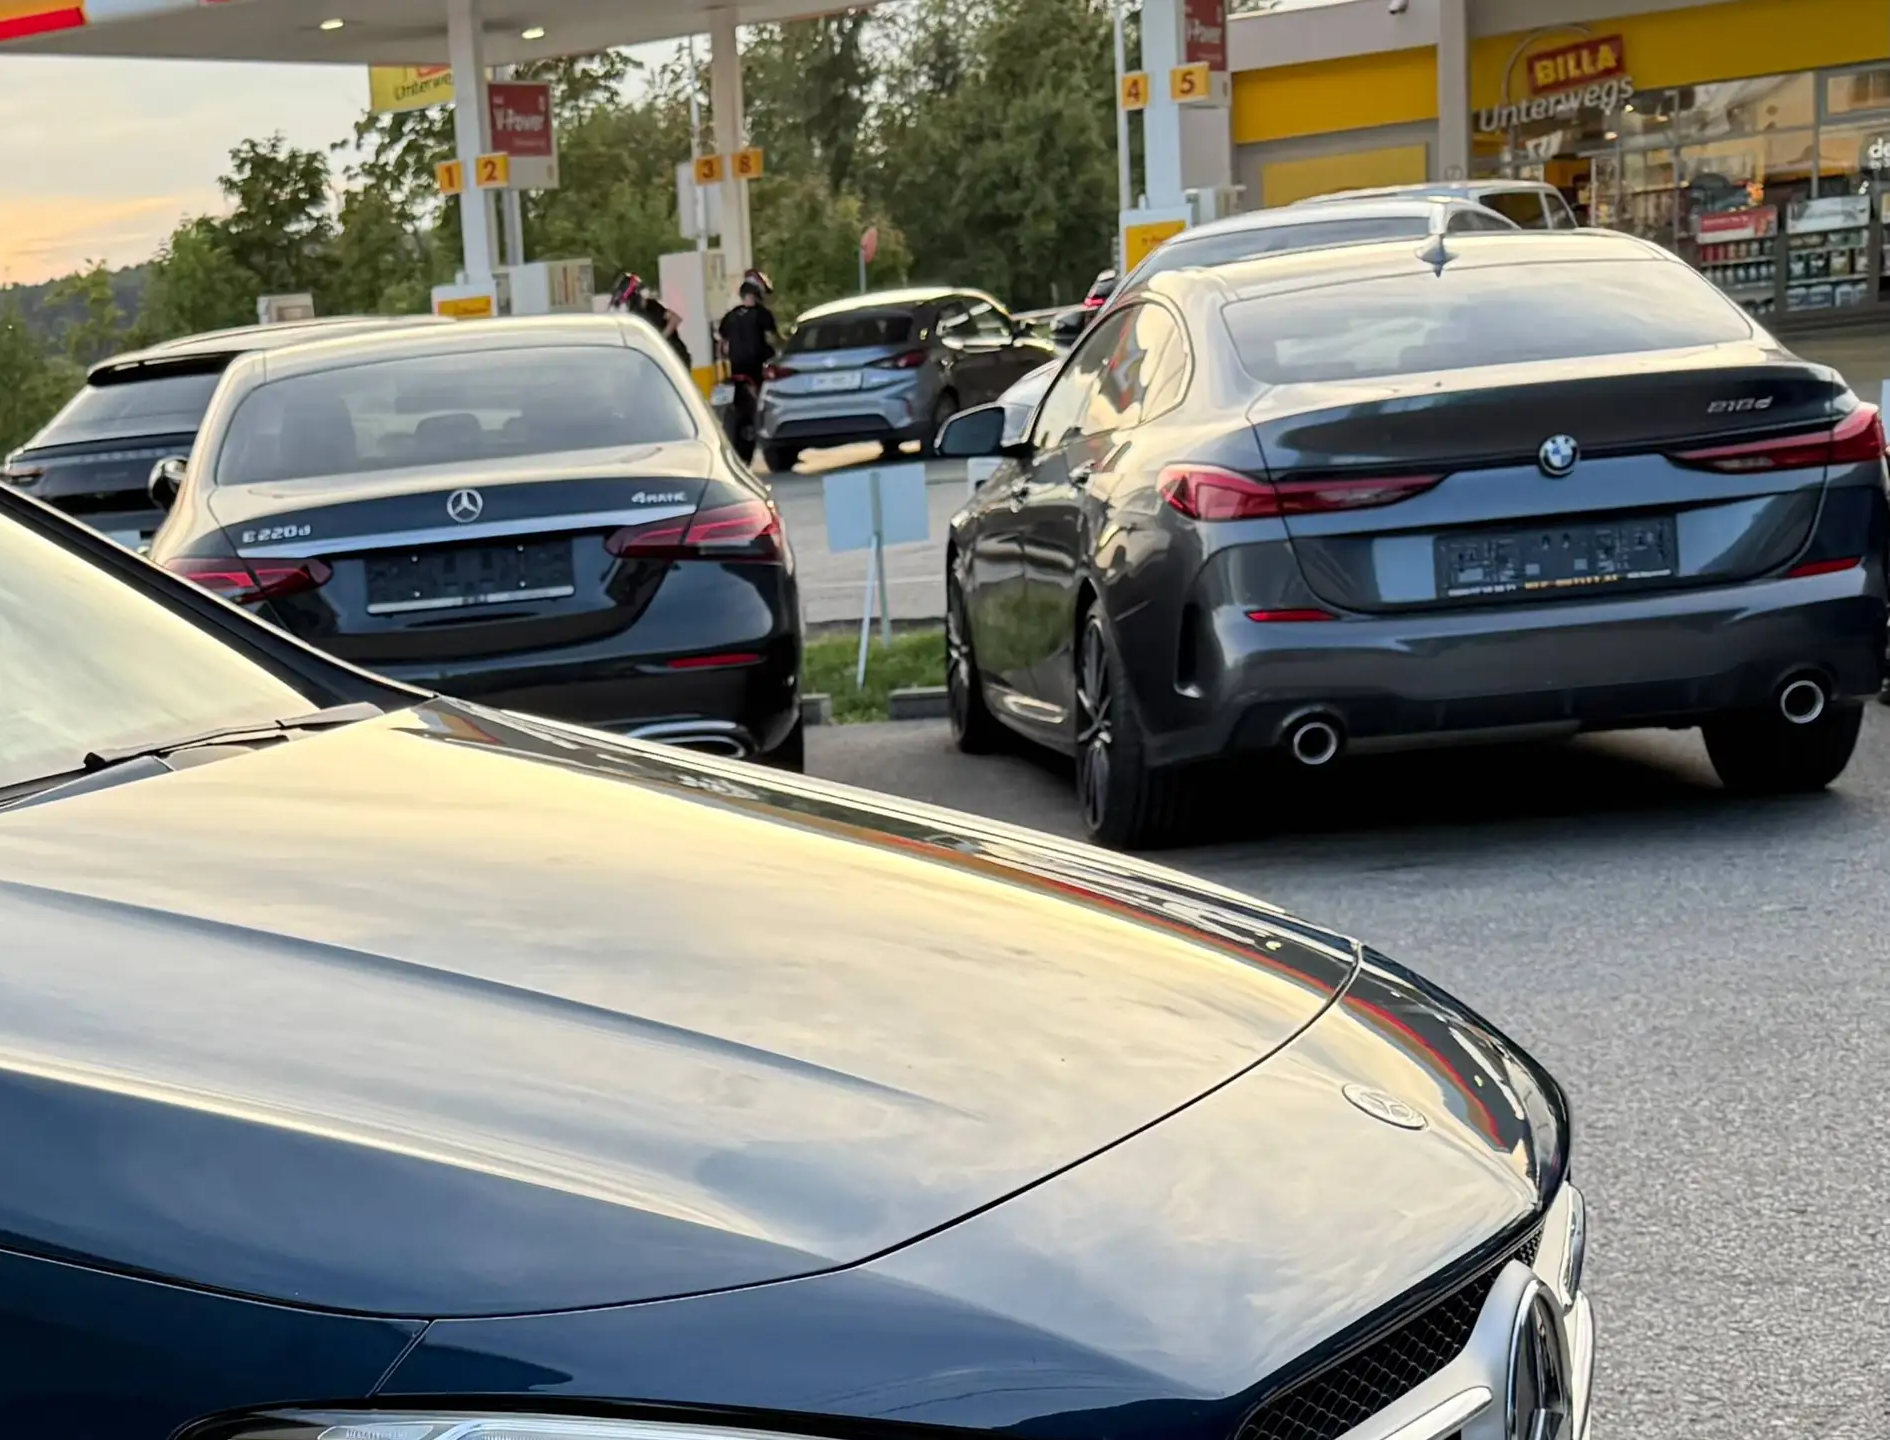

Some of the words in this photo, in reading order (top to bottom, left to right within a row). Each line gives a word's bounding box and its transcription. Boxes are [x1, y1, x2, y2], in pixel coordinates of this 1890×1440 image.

[1533, 43, 1617, 87] BILLA
[394, 71, 454, 101] Unterwe
[1126, 79, 1141, 102] 4
[1179, 71, 1196, 95] 5
[1478, 74, 1635, 132] Unterwegs
[444, 165, 455, 188] 1
[483, 159, 497, 182] 2
[701, 160, 715, 179] 3
